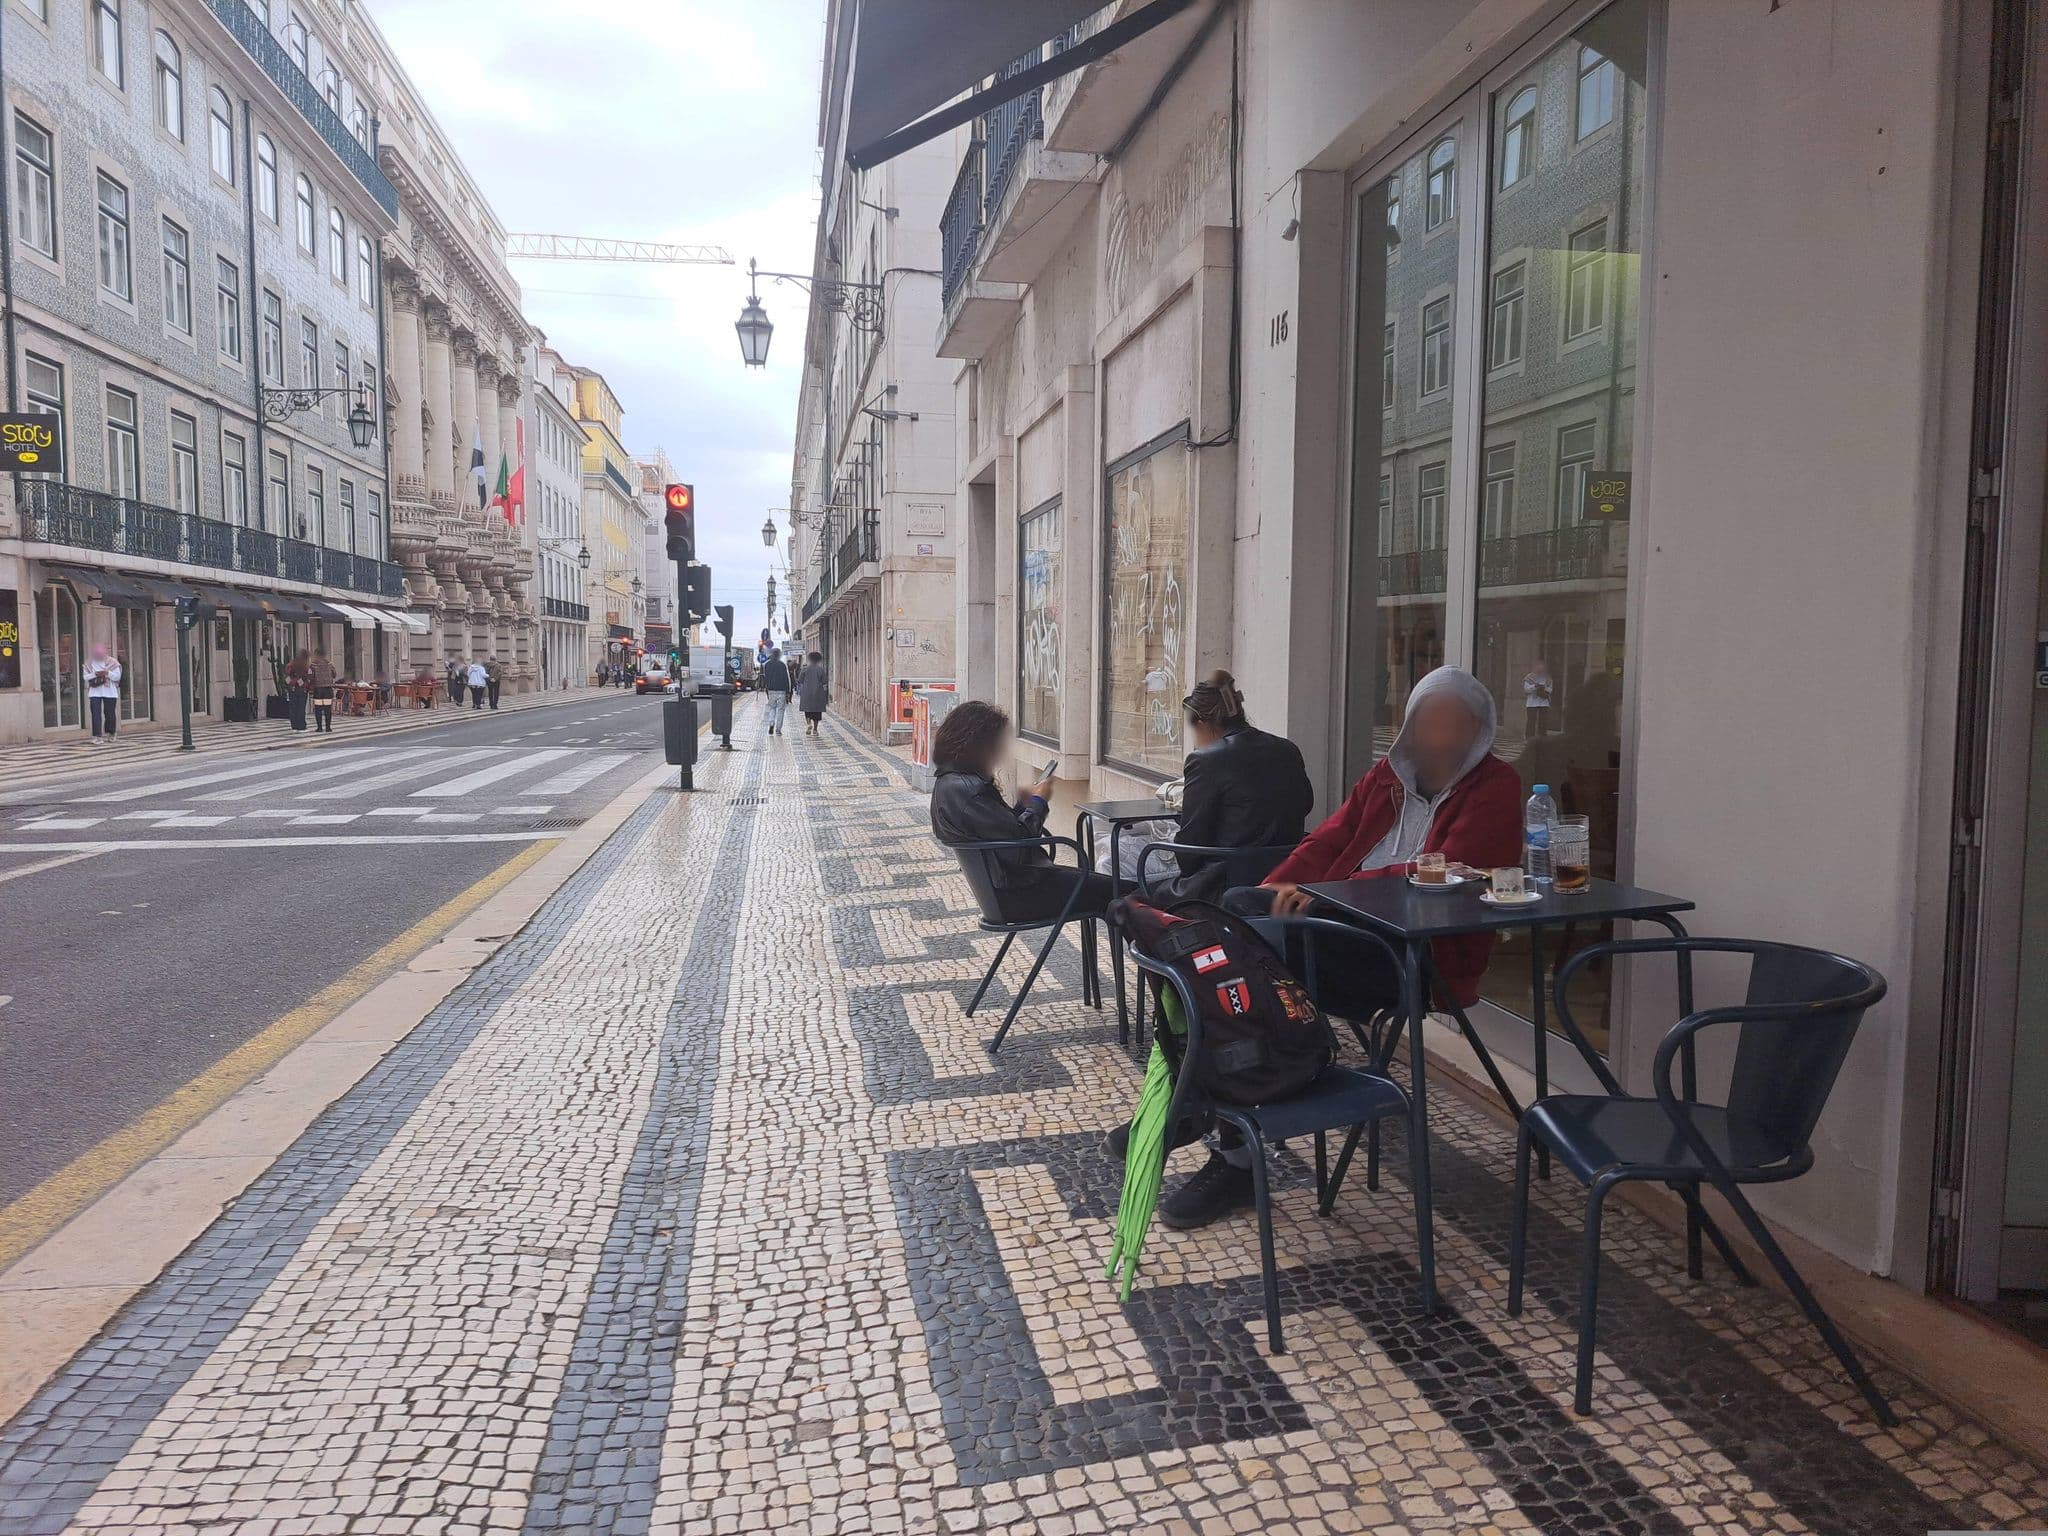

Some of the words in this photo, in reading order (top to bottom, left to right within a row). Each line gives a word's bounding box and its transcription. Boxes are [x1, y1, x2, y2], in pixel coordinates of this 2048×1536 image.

[1271, 310, 1288, 348] 116
[2, 424, 52, 447] Story
[4, 443, 40, 452] HOTEL
